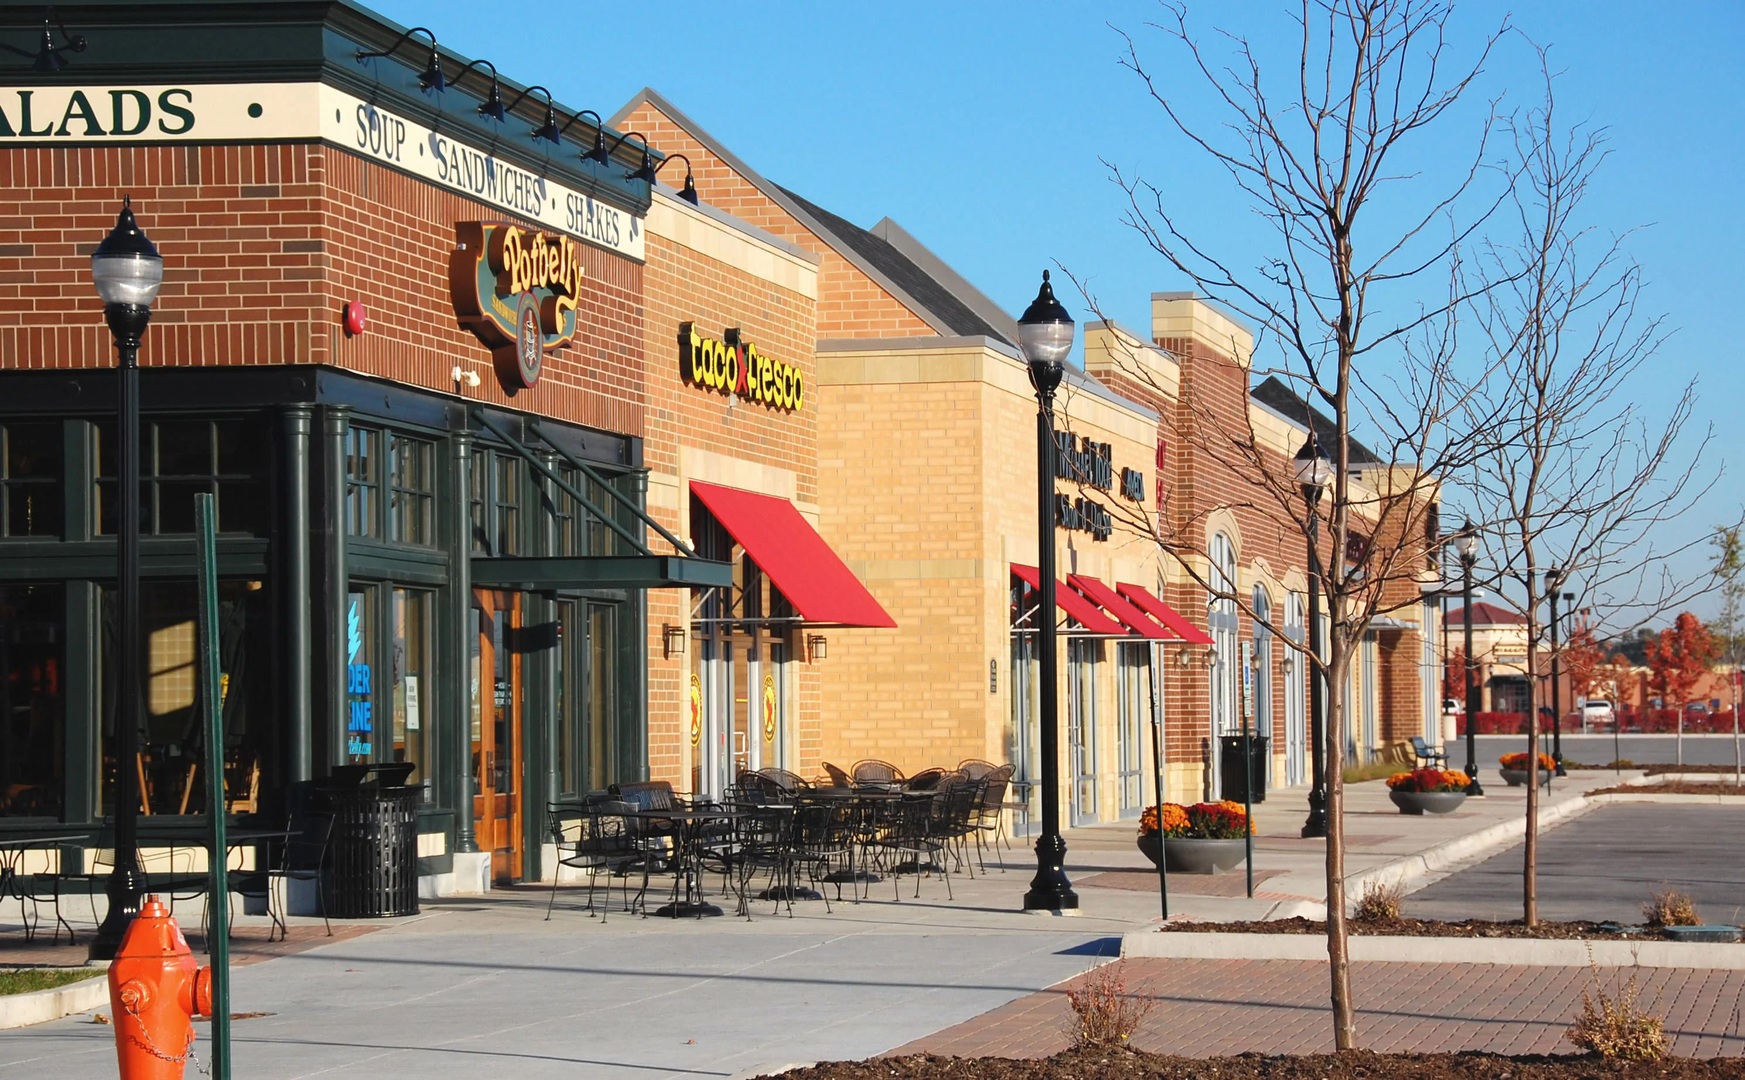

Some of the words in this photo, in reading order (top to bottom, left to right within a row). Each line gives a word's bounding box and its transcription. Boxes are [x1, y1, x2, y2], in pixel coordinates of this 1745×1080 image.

[356, 104, 405, 161] SOUP
[437, 138, 541, 217] SANDWICHES
[567, 193, 619, 247] SHAKES
[503, 226, 582, 334] Potbelly
[688, 321, 738, 392] taco
[747, 342, 803, 411] fresco
